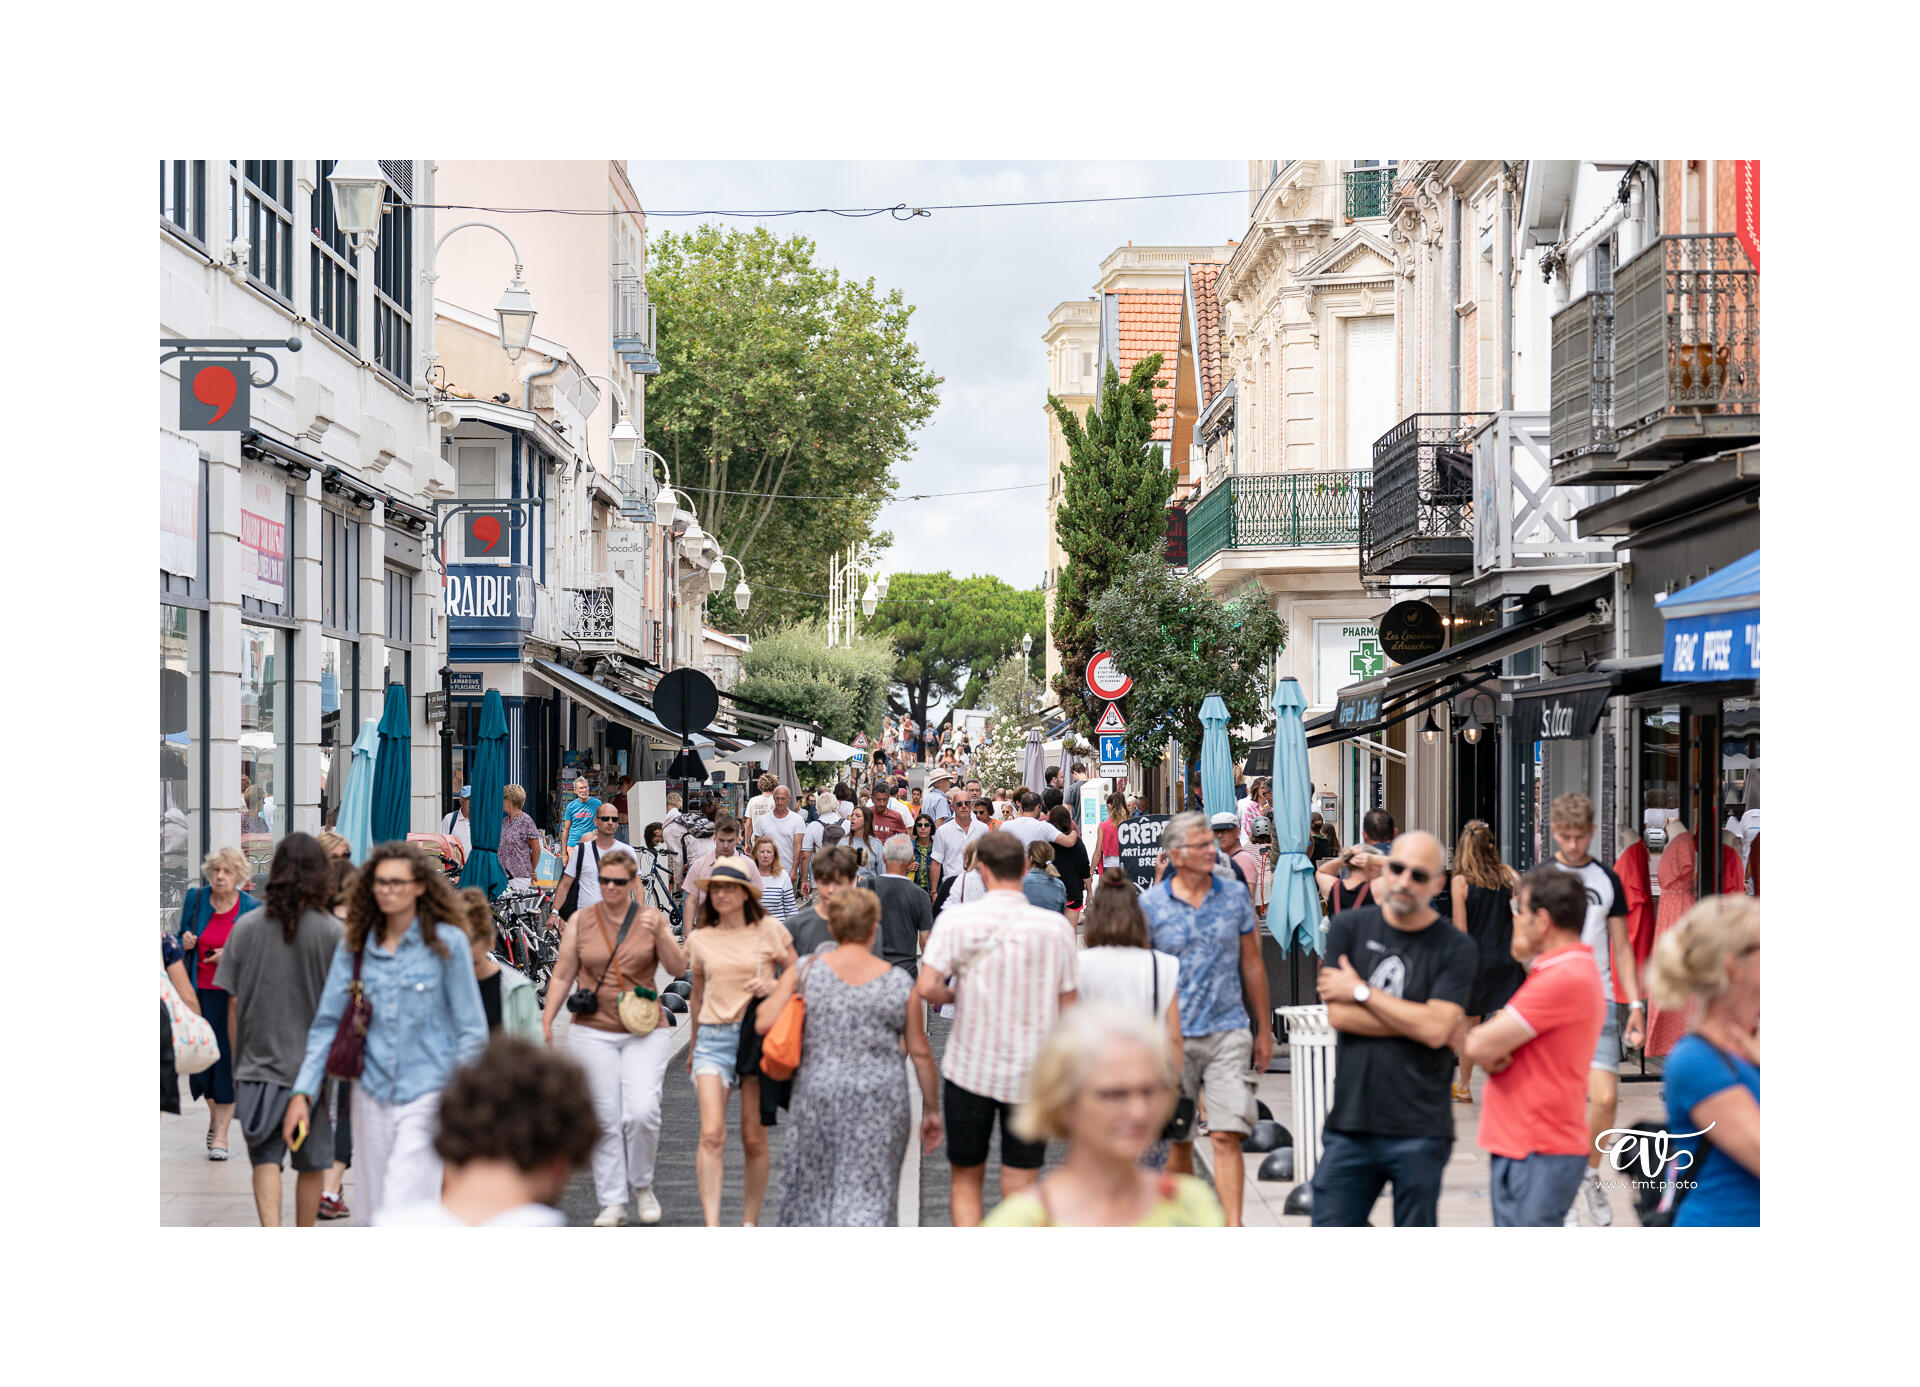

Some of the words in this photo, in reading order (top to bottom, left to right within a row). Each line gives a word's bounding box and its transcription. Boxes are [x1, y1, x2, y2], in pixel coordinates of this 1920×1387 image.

[607, 542, 643, 552] bocadillo
[444, 575, 512, 617] RAIRIE
[1342, 626, 1380, 637] PHARMA
[1138, 857, 1157, 867] BRE
